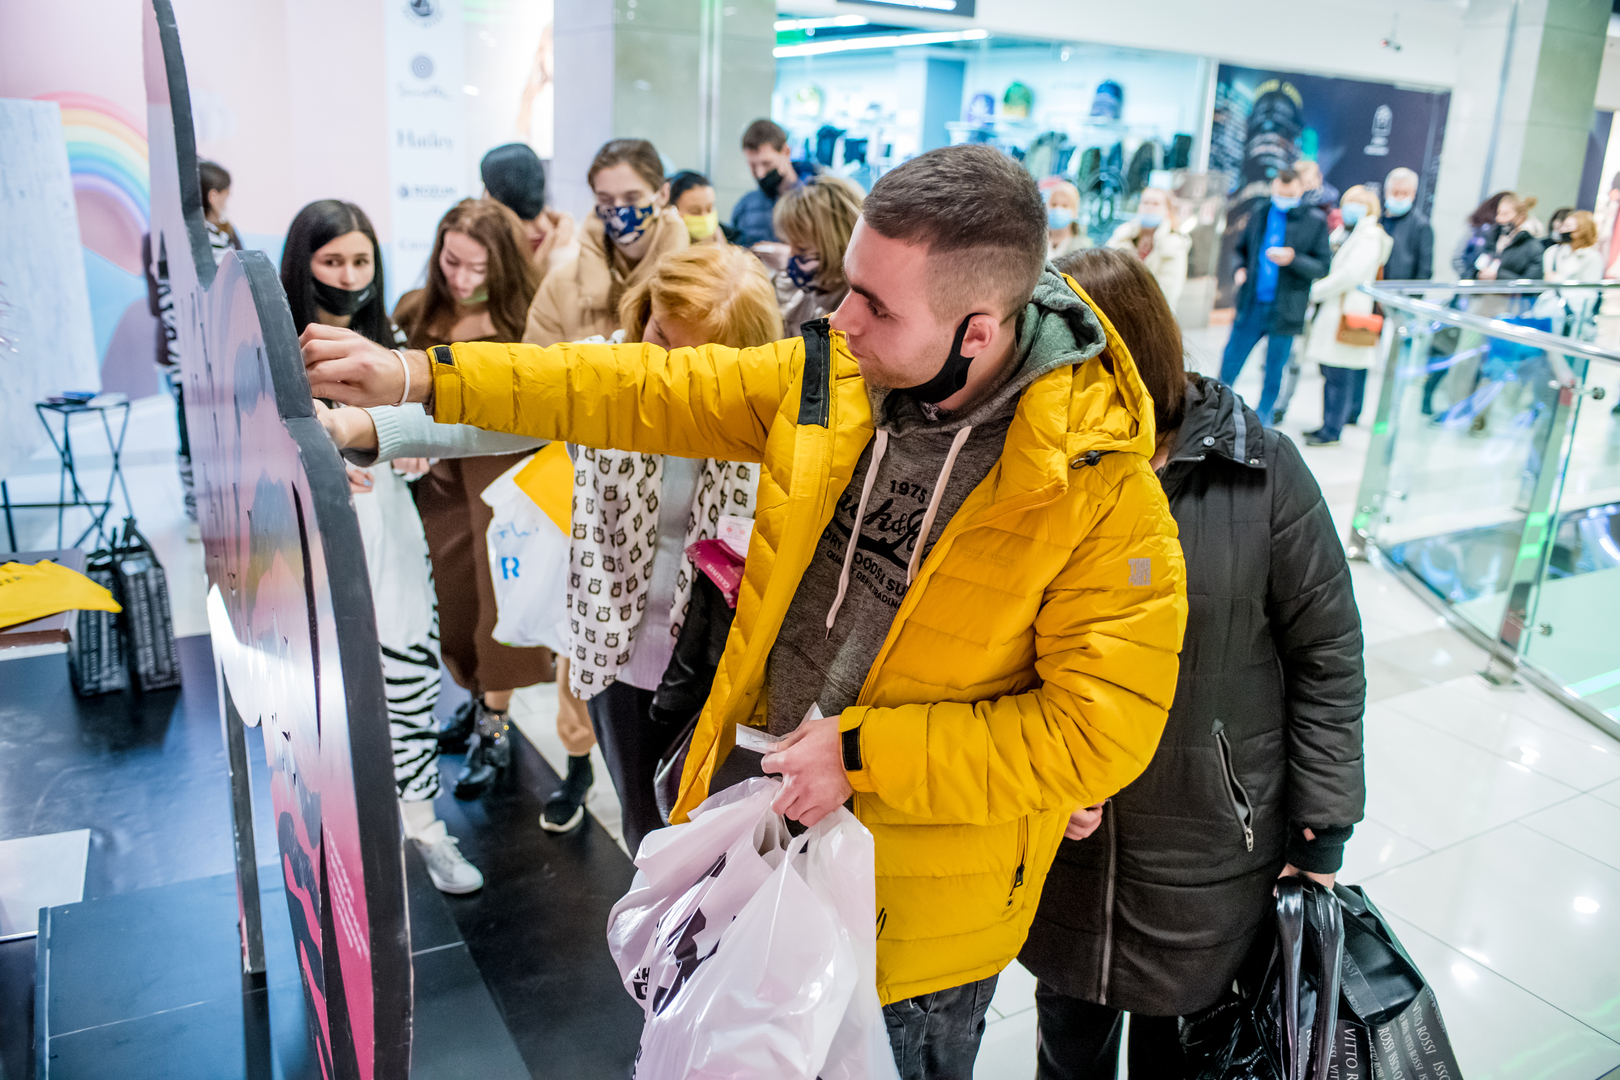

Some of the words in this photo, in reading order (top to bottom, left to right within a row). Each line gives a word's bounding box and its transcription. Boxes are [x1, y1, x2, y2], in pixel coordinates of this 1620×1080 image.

[890, 480, 928, 504] 1975
[821, 527, 843, 550] DRY
[853, 551, 883, 580] OODS
[885, 578, 909, 596] SU
[1342, 954, 1359, 977] OSSI
[1344, 1028, 1358, 1069] VITTO
[1377, 1026, 1396, 1053] ROSSI
[1416, 1025, 1437, 1055] ROSSI
[1409, 1049, 1424, 1071] ROSSI
